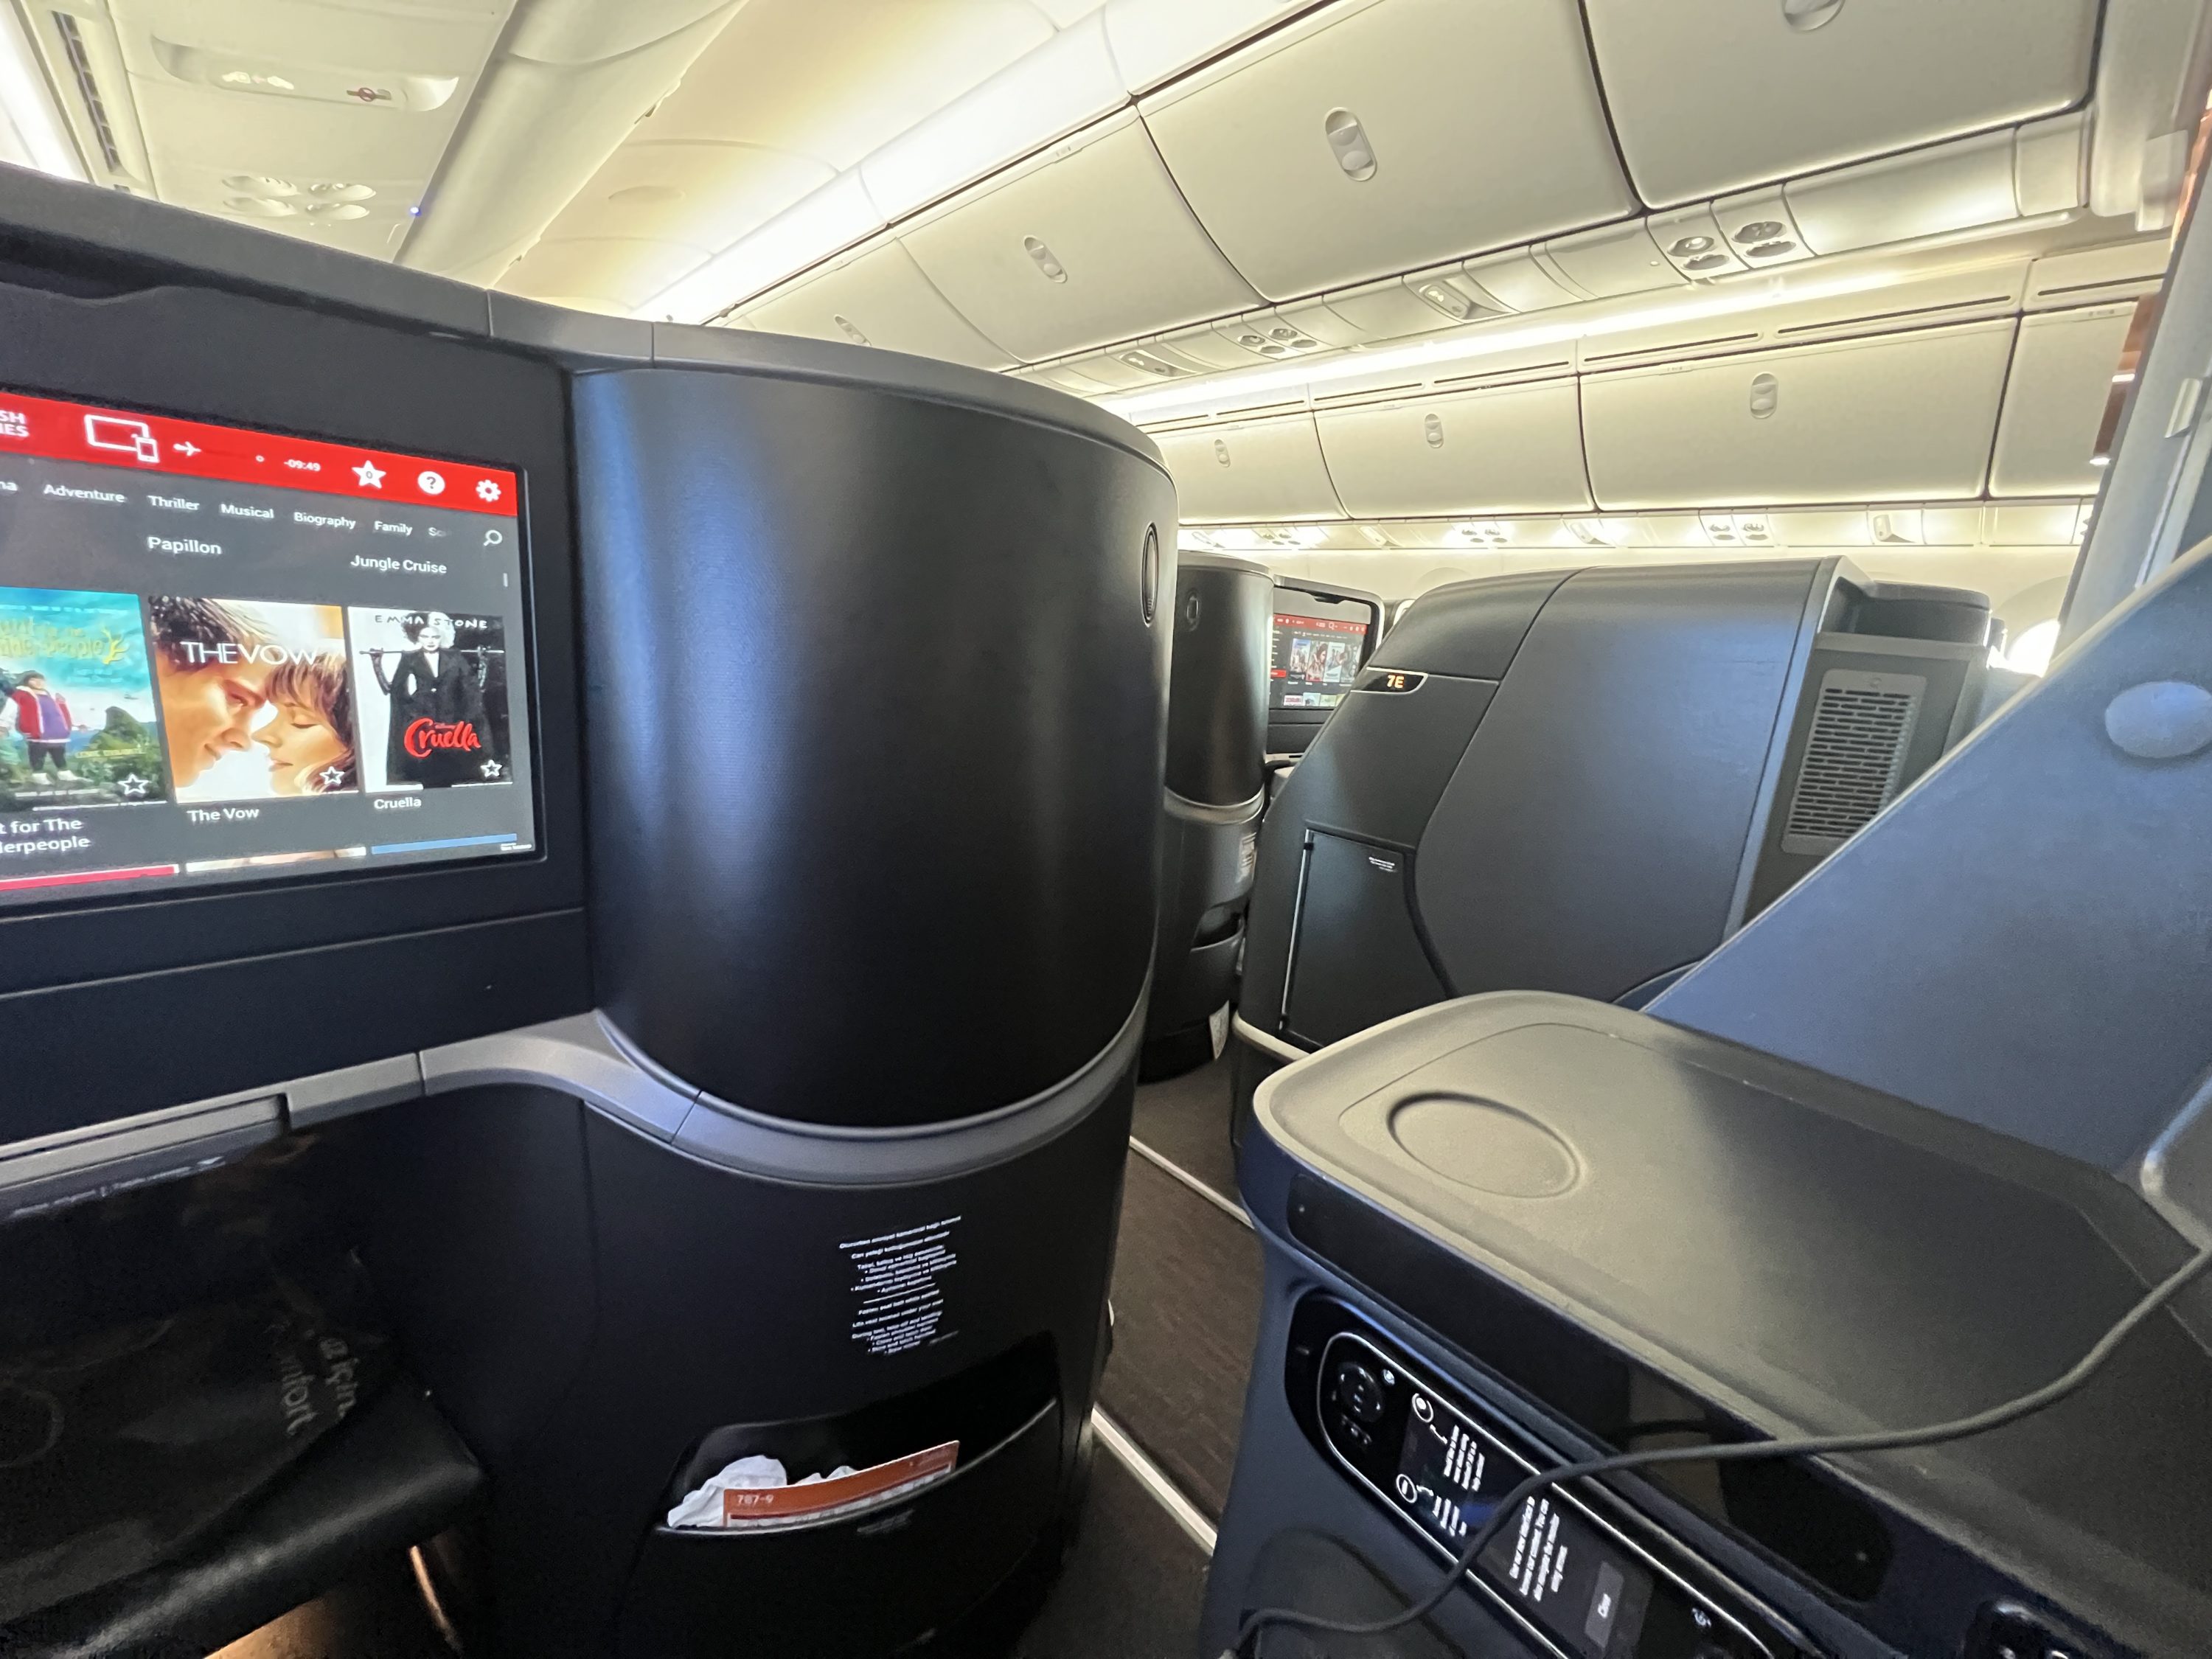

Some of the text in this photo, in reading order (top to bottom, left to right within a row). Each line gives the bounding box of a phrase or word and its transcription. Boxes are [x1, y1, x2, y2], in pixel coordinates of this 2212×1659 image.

[44, 484, 127, 503] Adventure
[147, 495, 201, 510] Thriller
[220, 504, 275, 518] Musical
[293, 512, 357, 530] Biography
[375, 521, 414, 536] Family
[147, 536, 223, 554] Papillon
[350, 554, 448, 574] Jungle Cruise
[375, 615, 487, 628] EMMA STONE
[1386, 675, 1405, 689] 7E
[403, 717, 481, 759] Cruella
[374, 796, 422, 810] Cruella
[187, 808, 260, 821] The Vow
[10, 820, 41, 833] for
[43, 818, 83, 832] The
[0, 835, 91, 855] erpeople
